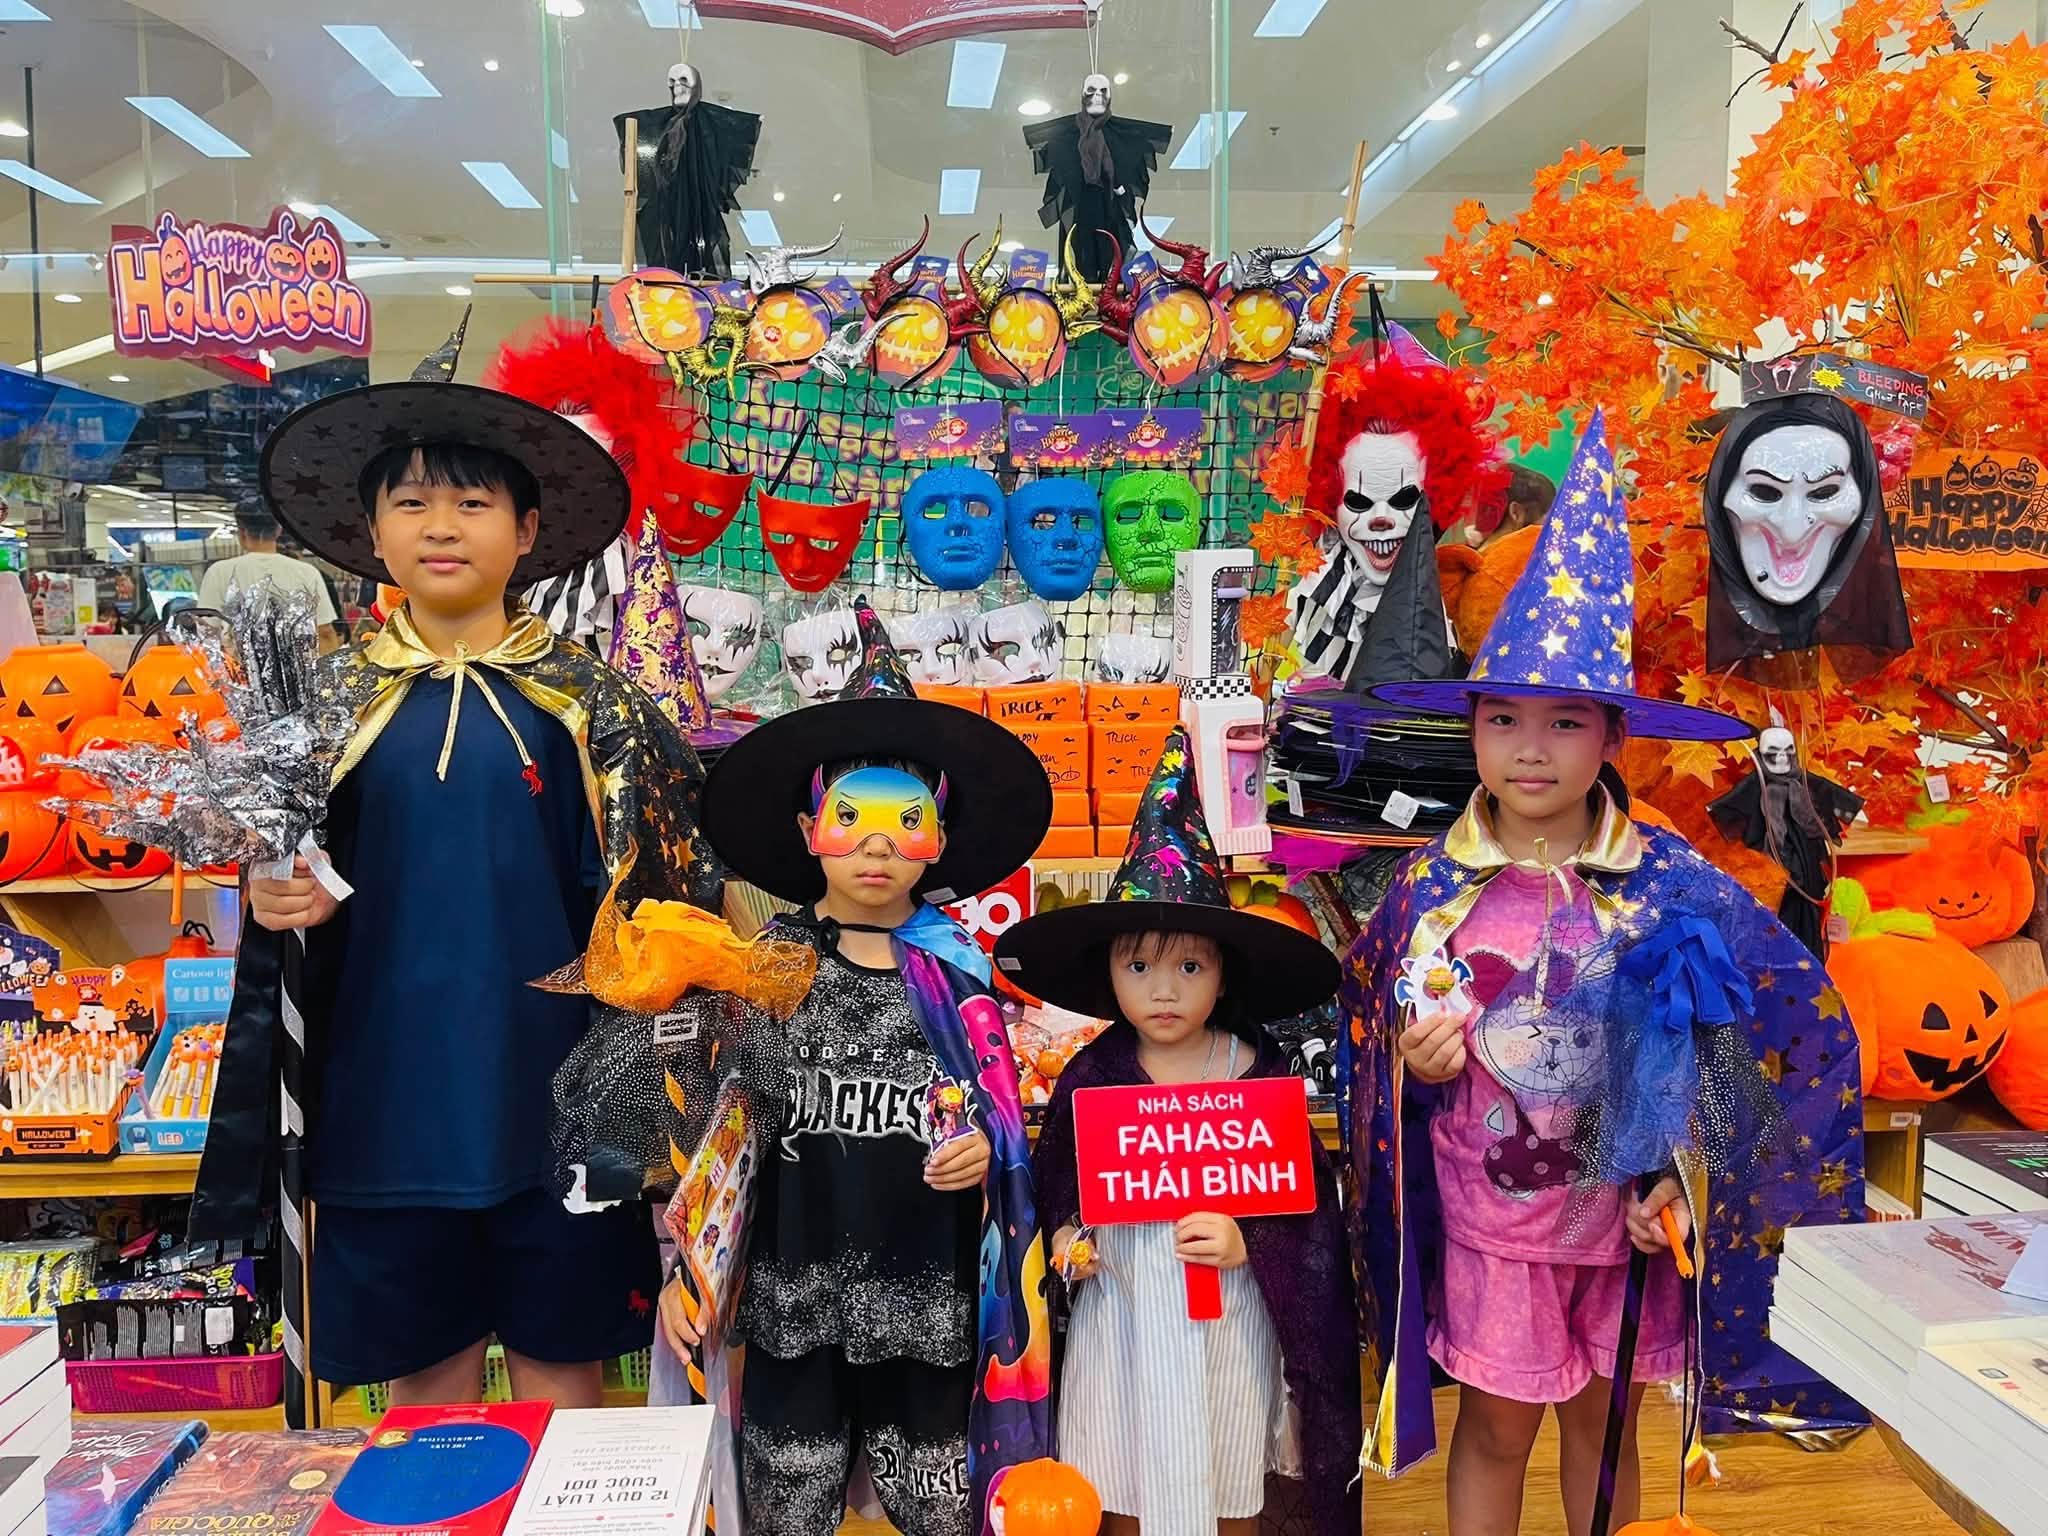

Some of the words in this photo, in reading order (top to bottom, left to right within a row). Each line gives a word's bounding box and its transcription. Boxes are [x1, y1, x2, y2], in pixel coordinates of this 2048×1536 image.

[188, 225, 264, 275] Happy
[113, 246, 365, 342] Halloween
[1857, 368, 1925, 397] BLEEDING
[1908, 476, 2032, 527] Happy
[999, 700, 1045, 718] TRICK
[1105, 731, 1140, 745] TRICK
[1138, 748, 1152, 758] or
[71, 974, 107, 987] HAPPY
[171, 967, 215, 979] Cartoon
[1137, 1093, 1183, 1114] NHÀ
[1186, 1091, 1244, 1112] SÁCH
[157, 1131, 183, 1146] LED
[1117, 1117, 1274, 1157] FAHASA
[1097, 1160, 1190, 1202] THÁI
[1201, 1157, 1297, 1197] BÌNH
[601, 1490, 643, 1503] QUY
[651, 1489, 670, 1501] 12
